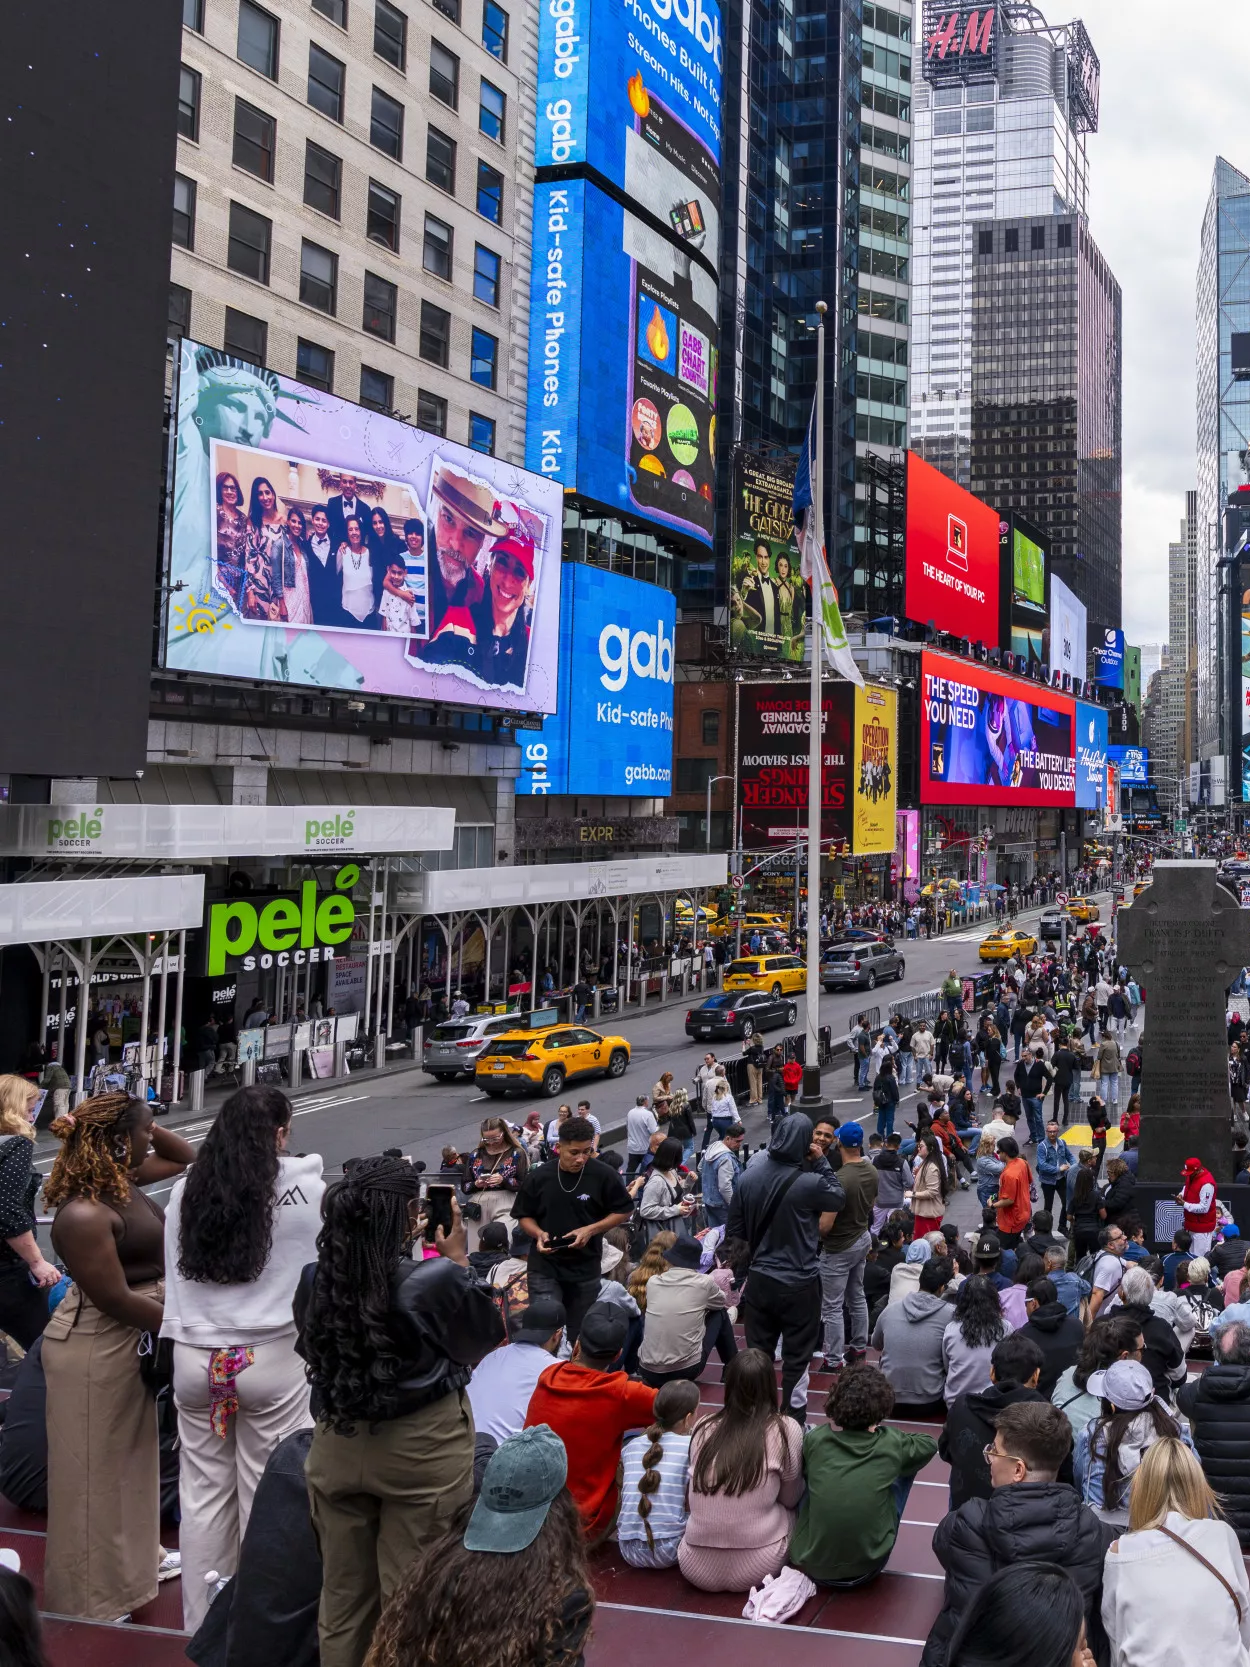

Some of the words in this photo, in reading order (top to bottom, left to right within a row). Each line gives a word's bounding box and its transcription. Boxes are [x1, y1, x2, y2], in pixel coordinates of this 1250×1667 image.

[550, 0, 580, 79] gabb
[927, 8, 995, 60] H&M
[627, 32, 668, 81] Stream
[670, 74, 692, 105] Hits.
[693, 96, 709, 121] Not
[679, 47, 707, 88] Built
[546, 99, 577, 164] gab
[547, 190, 569, 306] Kid-safe
[543, 310, 565, 408] Phones
[743, 493, 764, 515] THE
[765, 500, 795, 522] GREA
[749, 513, 795, 541] GATSBY
[922, 562, 935, 579] THE
[935, 568, 954, 588] HEART
[954, 578, 963, 591] OF
[962, 582, 978, 600] YOUR
[977, 590, 985, 604] PC
[599, 619, 675, 692] gab
[1101, 656, 1118, 666] Outdoor
[924, 673, 947, 700] THE
[947, 680, 979, 707] SPEED
[597, 702, 659, 730] Kid-safe
[756, 700, 793, 711] DOWN
[761, 711, 804, 723] TURNED
[806, 711, 828, 722] HS
[924, 699, 947, 725] YOU
[949, 704, 976, 730] NEED
[762, 722, 826, 734] BOADWAY
[862, 723, 890, 746] OPERATION
[742, 754, 788, 766] SHADOW
[824, 754, 846, 766] THE
[1019, 750, 1035, 769] THE
[1035, 752, 1064, 773] BATTERY
[1063, 754, 1076, 774] LIFE
[625, 763, 672, 786] gabb.com
[1039, 772, 1054, 790] YOU
[743, 783, 846, 805] STANGER
[47, 807, 104, 846] pelé
[305, 809, 356, 846] pelé
[58, 838, 91, 847] SOCCER
[315, 837, 345, 845] SOCCER
[208, 863, 361, 978] pelé
[243, 946, 335, 972] SOCCER
[335, 960, 367, 972] RESTAURAN
[51, 978, 71, 989] TE
[75, 973, 118, 988] WRLD'S
[335, 970, 352, 979] SPACE
[335, 976, 364, 988] AVAILABLE
[212, 983, 237, 1002] pelé
